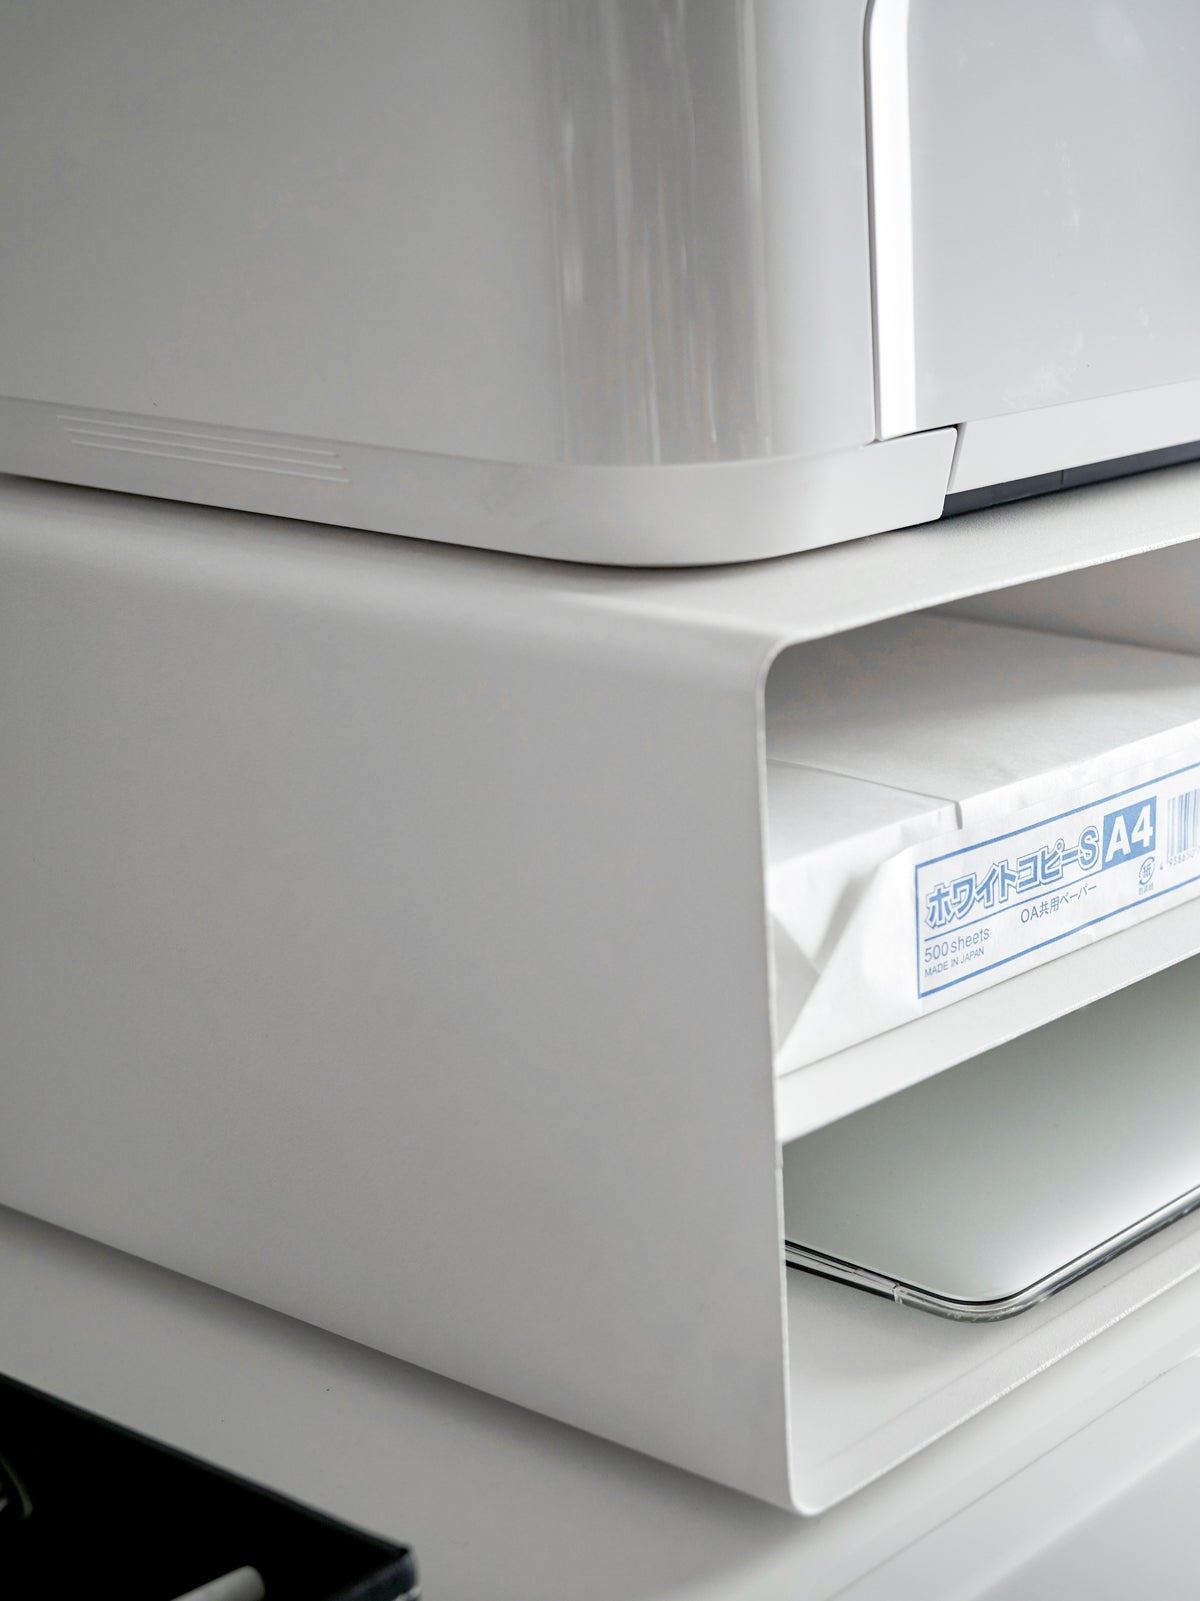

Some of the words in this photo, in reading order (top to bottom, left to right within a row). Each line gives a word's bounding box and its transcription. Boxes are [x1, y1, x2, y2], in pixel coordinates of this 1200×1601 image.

[1104, 804, 1153, 862] A4
[1019, 884, 1098, 924] OA共用ペーパー
[924, 960, 949, 977] MADE
[950, 956, 959, 968] IN
[960, 946, 985, 964] JAPAN
